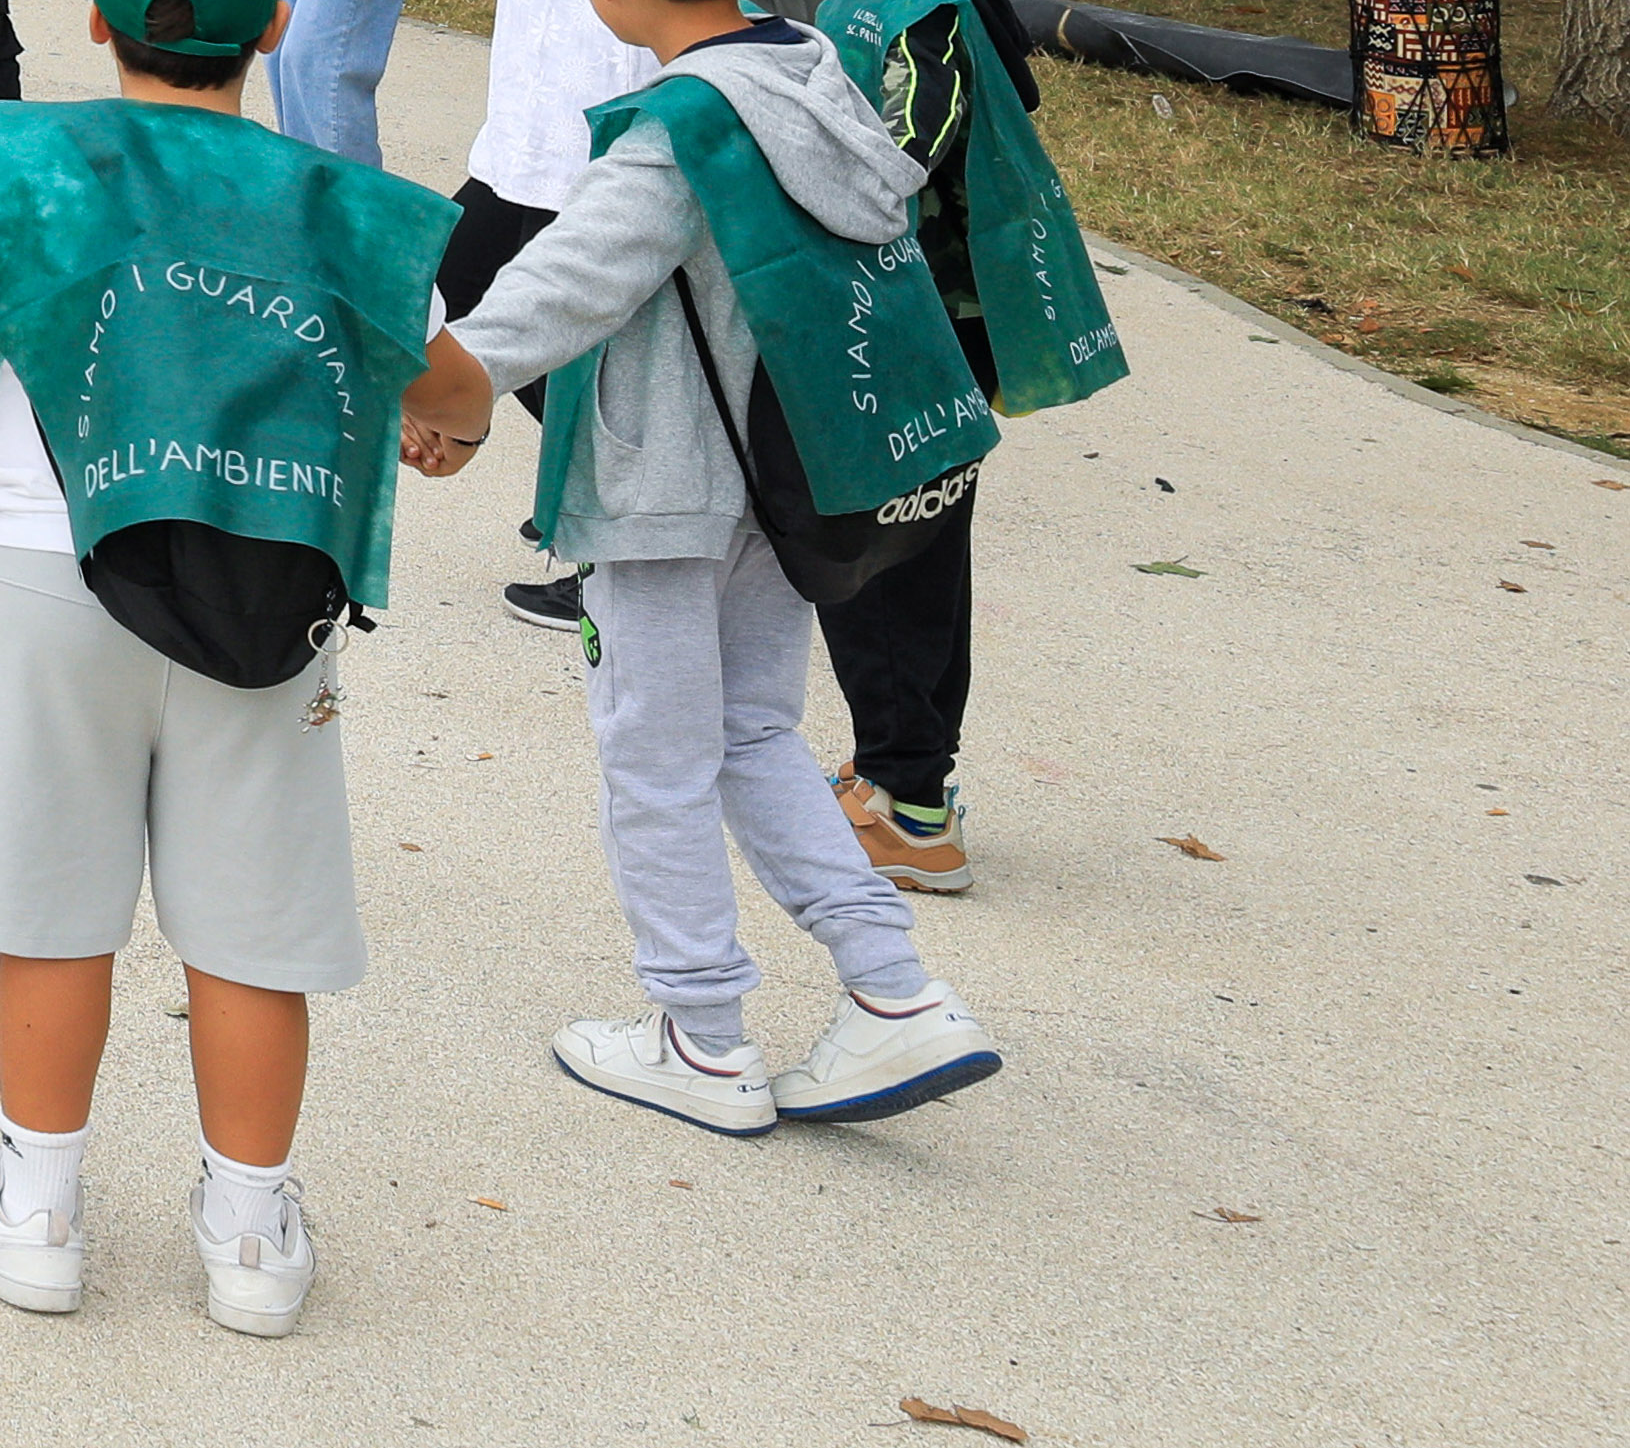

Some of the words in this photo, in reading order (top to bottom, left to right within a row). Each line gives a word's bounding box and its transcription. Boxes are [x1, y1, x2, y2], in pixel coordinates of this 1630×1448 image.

[1032, 218, 1055, 321] SIAMO
[77, 288, 116, 440] SIAMO
[131, 263, 145, 292] I
[166, 261, 355, 442] GUARDIANI
[847, 280, 878, 414] SIAMO
[84, 438, 345, 508] DELL'AMBIENTE
